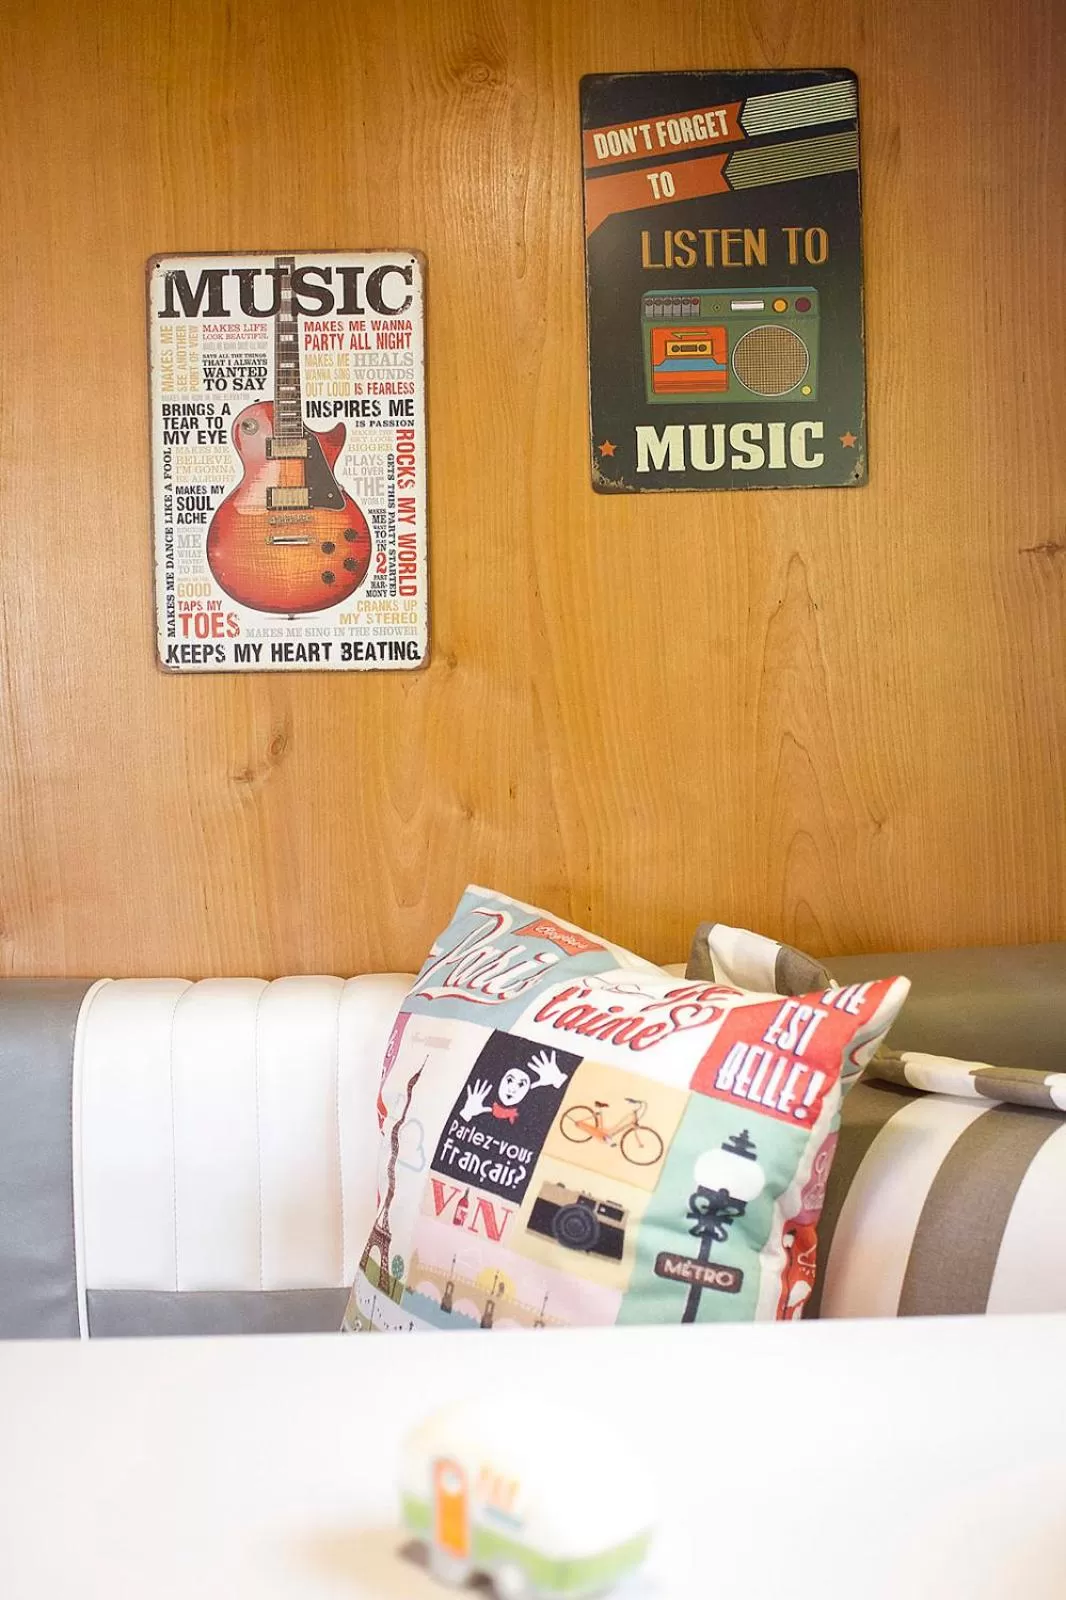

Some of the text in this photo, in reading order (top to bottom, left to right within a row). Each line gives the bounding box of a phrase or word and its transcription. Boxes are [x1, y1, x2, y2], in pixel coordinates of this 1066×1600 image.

[593, 110, 728, 159] DON'T FORGET
[647, 171, 676, 199] TO
[641, 228, 829, 268] LISTEN TO
[158, 265, 412, 318] MUSIC
[203, 323, 268, 333] MAKES LIFE
[304, 320, 413, 332] MAKES ME WANNA
[304, 332, 412, 351] PARTY ALL NIGHT
[160, 325, 174, 392] MAKES ME
[305, 353, 350, 367] MAKES ME
[353, 352, 414, 367] HEALS
[203, 367, 268, 378] WANTED
[353, 368, 414, 380] WOUNDS
[204, 378, 267, 391] TO SAY
[305, 381, 350, 397] OUT LOUD
[355, 382, 415, 396] IS FEARLESS
[162, 403, 232, 417] BRINGS A
[306, 399, 415, 418] INSPIRES ME
[163, 416, 223, 430] TEAR TO
[356, 419, 415, 428] IS PASSION
[163, 430, 228, 445] MY EYE
[635, 421, 825, 472] MUSIC
[345, 454, 384, 467] PLAYS
[343, 467, 384, 476] ALL OVER
[176, 485, 225, 495] MAKES MY
[353, 477, 385, 497] THE
[176, 496, 214, 511] SOUL
[177, 512, 207, 525] ACHE
[372, 515, 387, 524] ME
[396, 429, 417, 597] ROCKS MY WORLD
[375, 531, 387, 539] TO
[388, 512, 396, 546] PARTY
[163, 447, 176, 639] MAKES ME DANCE LIKE A FOOL
[177, 534, 202, 548] ME
[377, 544, 387, 552] IN
[376, 552, 388, 574] 2
[389, 549, 397, 597] STARTED
[177, 583, 212, 598] GOOD
[366, 590, 388, 598] MONY
[178, 600, 222, 612] TAPS MY
[357, 600, 418, 613] CRANKS UP
[178, 612, 240, 639] TOES
[340, 613, 418, 625] MY STEREO
[246, 626, 418, 638] MAKES ME SING IN THE SHOWER
[166, 641, 421, 663] KEEPS MY HEART BEATING
[763, 999, 829, 1057] EST
[715, 1041, 828, 1120] BELLE!
[440, 1138, 527, 1189] français?
[663, 1259, 735, 1287] MÉTRO
